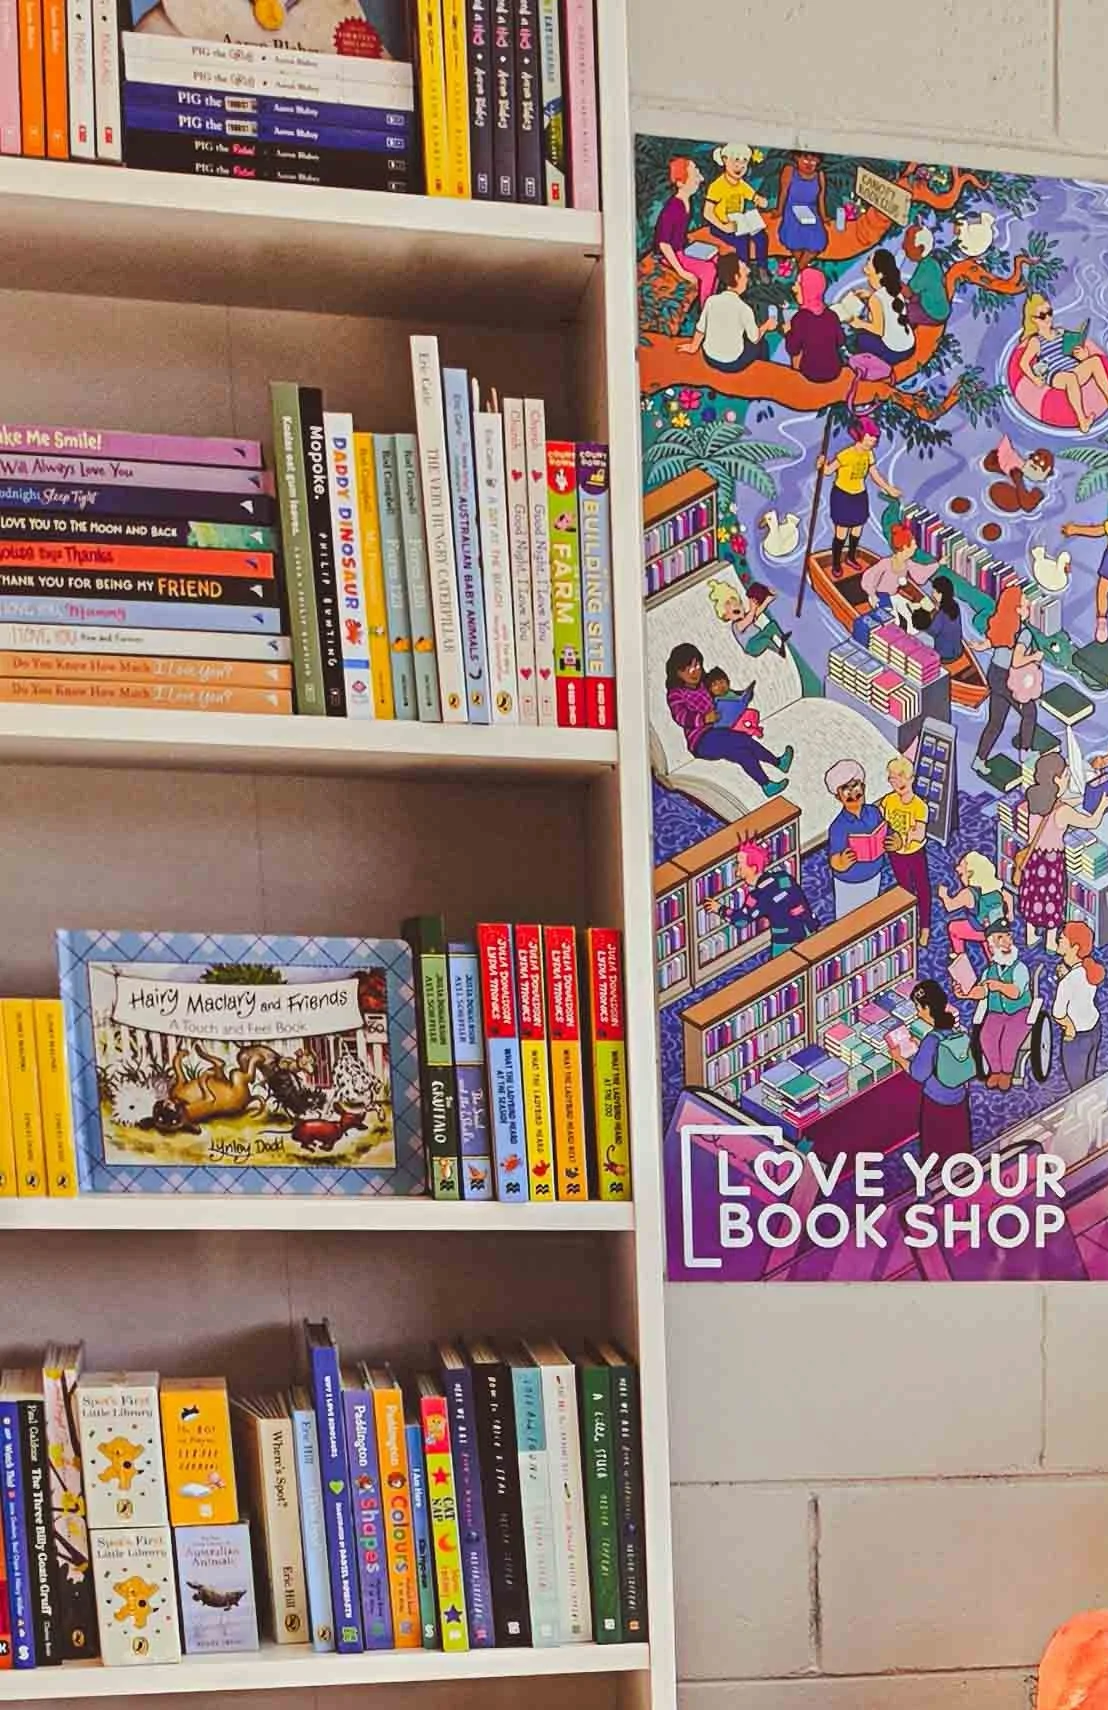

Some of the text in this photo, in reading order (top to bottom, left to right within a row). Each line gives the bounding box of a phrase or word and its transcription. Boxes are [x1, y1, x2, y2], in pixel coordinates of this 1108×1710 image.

[178, 91, 221, 108] PIG the
[178, 115, 222, 131] PIG the
[27, 430, 101, 450] Me Smile!
[32, 458, 75, 479] Always
[80, 462, 105, 477] Love
[111, 462, 133, 477] You
[308, 425, 328, 500] Mopoke.
[426, 449, 441, 474] THE
[1, 516, 178, 536] LOVE YOU TO THE MOON AND BACK
[332, 436, 359, 609] DADDY DINOSAUR
[458, 496, 474, 569] AUSTRALIAN
[38, 577, 64, 588] YOU
[68, 577, 92, 589] FOR
[96, 578, 133, 591] BEING
[137, 581, 154, 592] MY
[158, 578, 223, 598] FRIEND
[463, 574, 476, 605] BABY
[552, 542, 574, 624] FARM
[583, 499, 606, 674] BUILDING SITE
[464, 609, 480, 662] ANIMALS
[129, 988, 348, 1018] Hairy Maclary and Friends
[169, 1019, 308, 1034] A Touch and Feel Book
[431, 1081, 447, 1143] GRUFFALO
[209, 1137, 286, 1163] Lynley Dodd
[718, 1150, 1066, 1199] LOVE YOUR
[718, 1203, 1066, 1249] BOOK SHOP
[273, 1431, 286, 1475] Where's
[354, 1406, 382, 1573] Paddington Shapes
[431, 1498, 443, 1522] NAP
[444, 1498, 455, 1521] CAT
[31, 1468, 52, 1616] The Three Billy Goats Gruff
[390, 1495, 411, 1573] Colours
[282, 1566, 293, 1588] Eric
[284, 1590, 296, 1608] Hill
